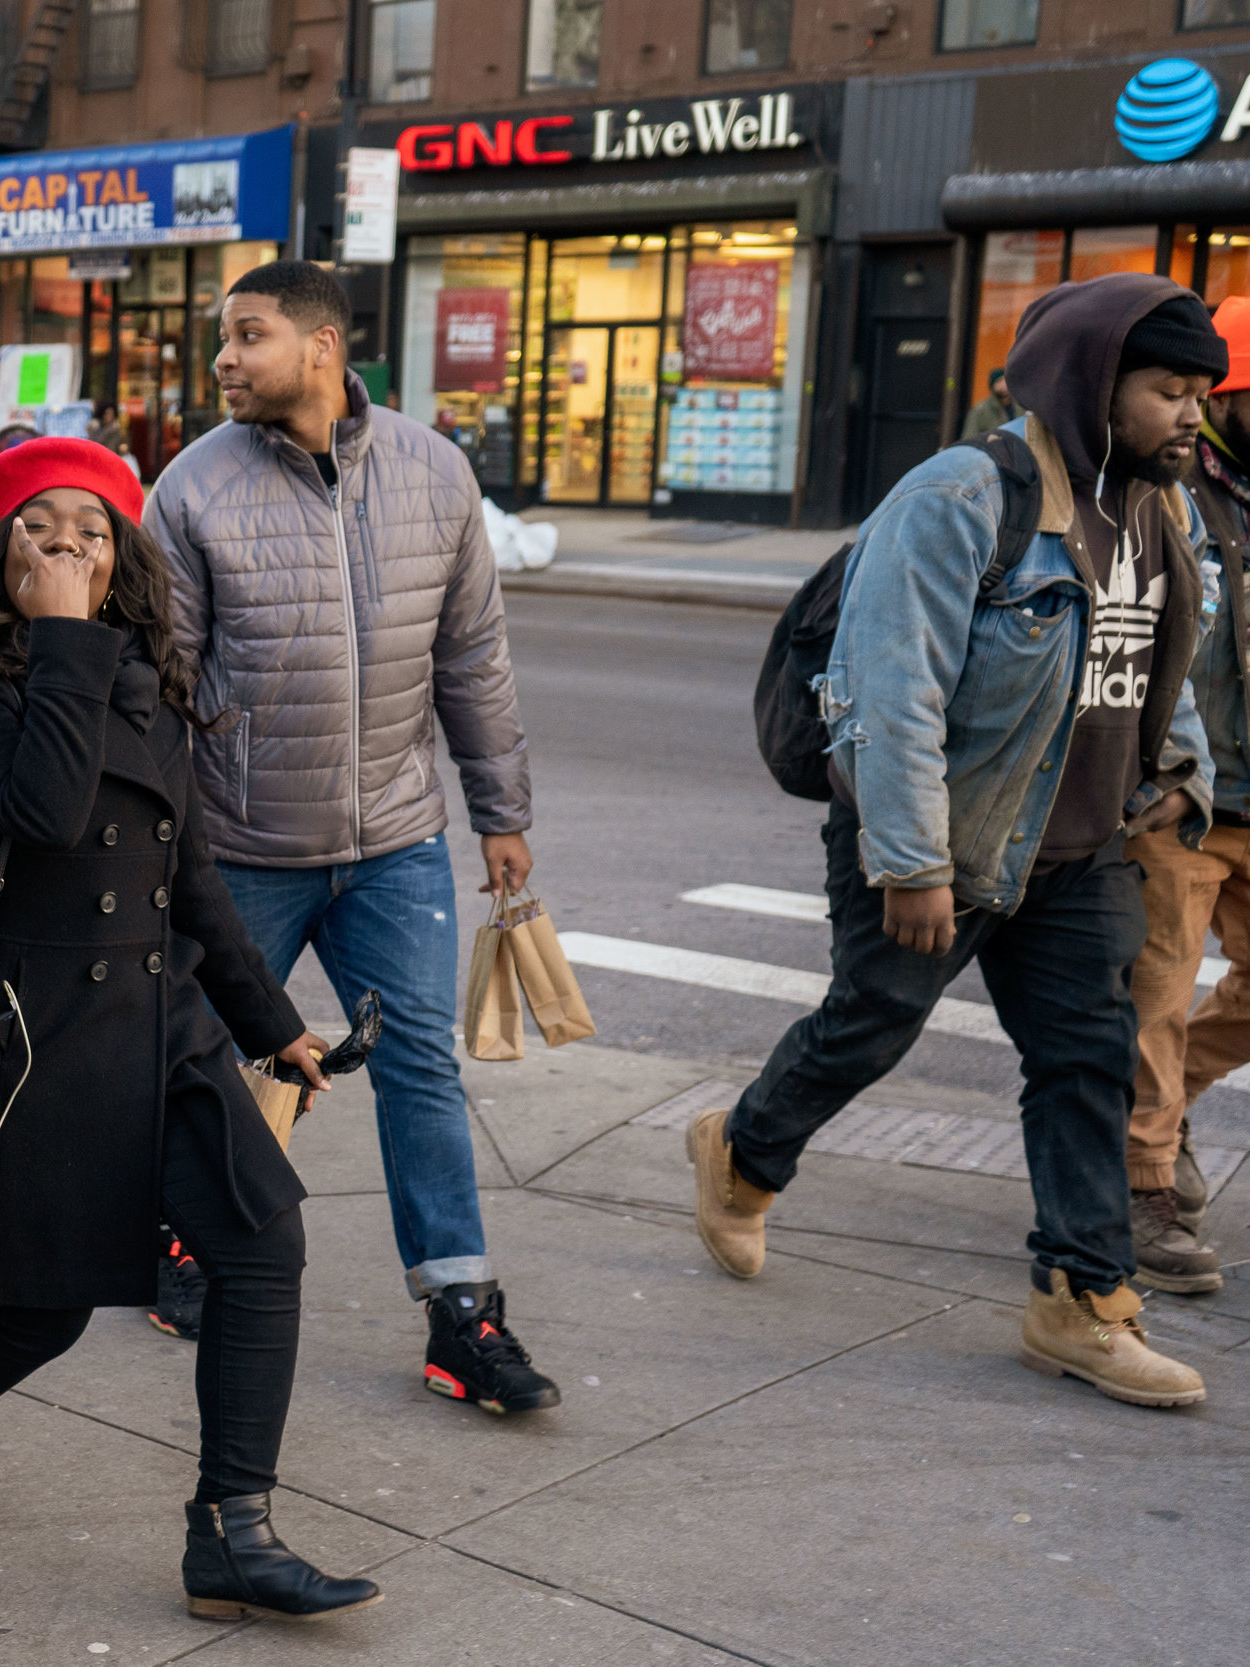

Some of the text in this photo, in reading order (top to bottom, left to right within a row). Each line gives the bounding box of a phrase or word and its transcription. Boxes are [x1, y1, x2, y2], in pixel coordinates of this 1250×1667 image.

[396, 115, 575, 172] GNC
[592, 108, 690, 162] Live
[691, 93, 802, 154] Well.
